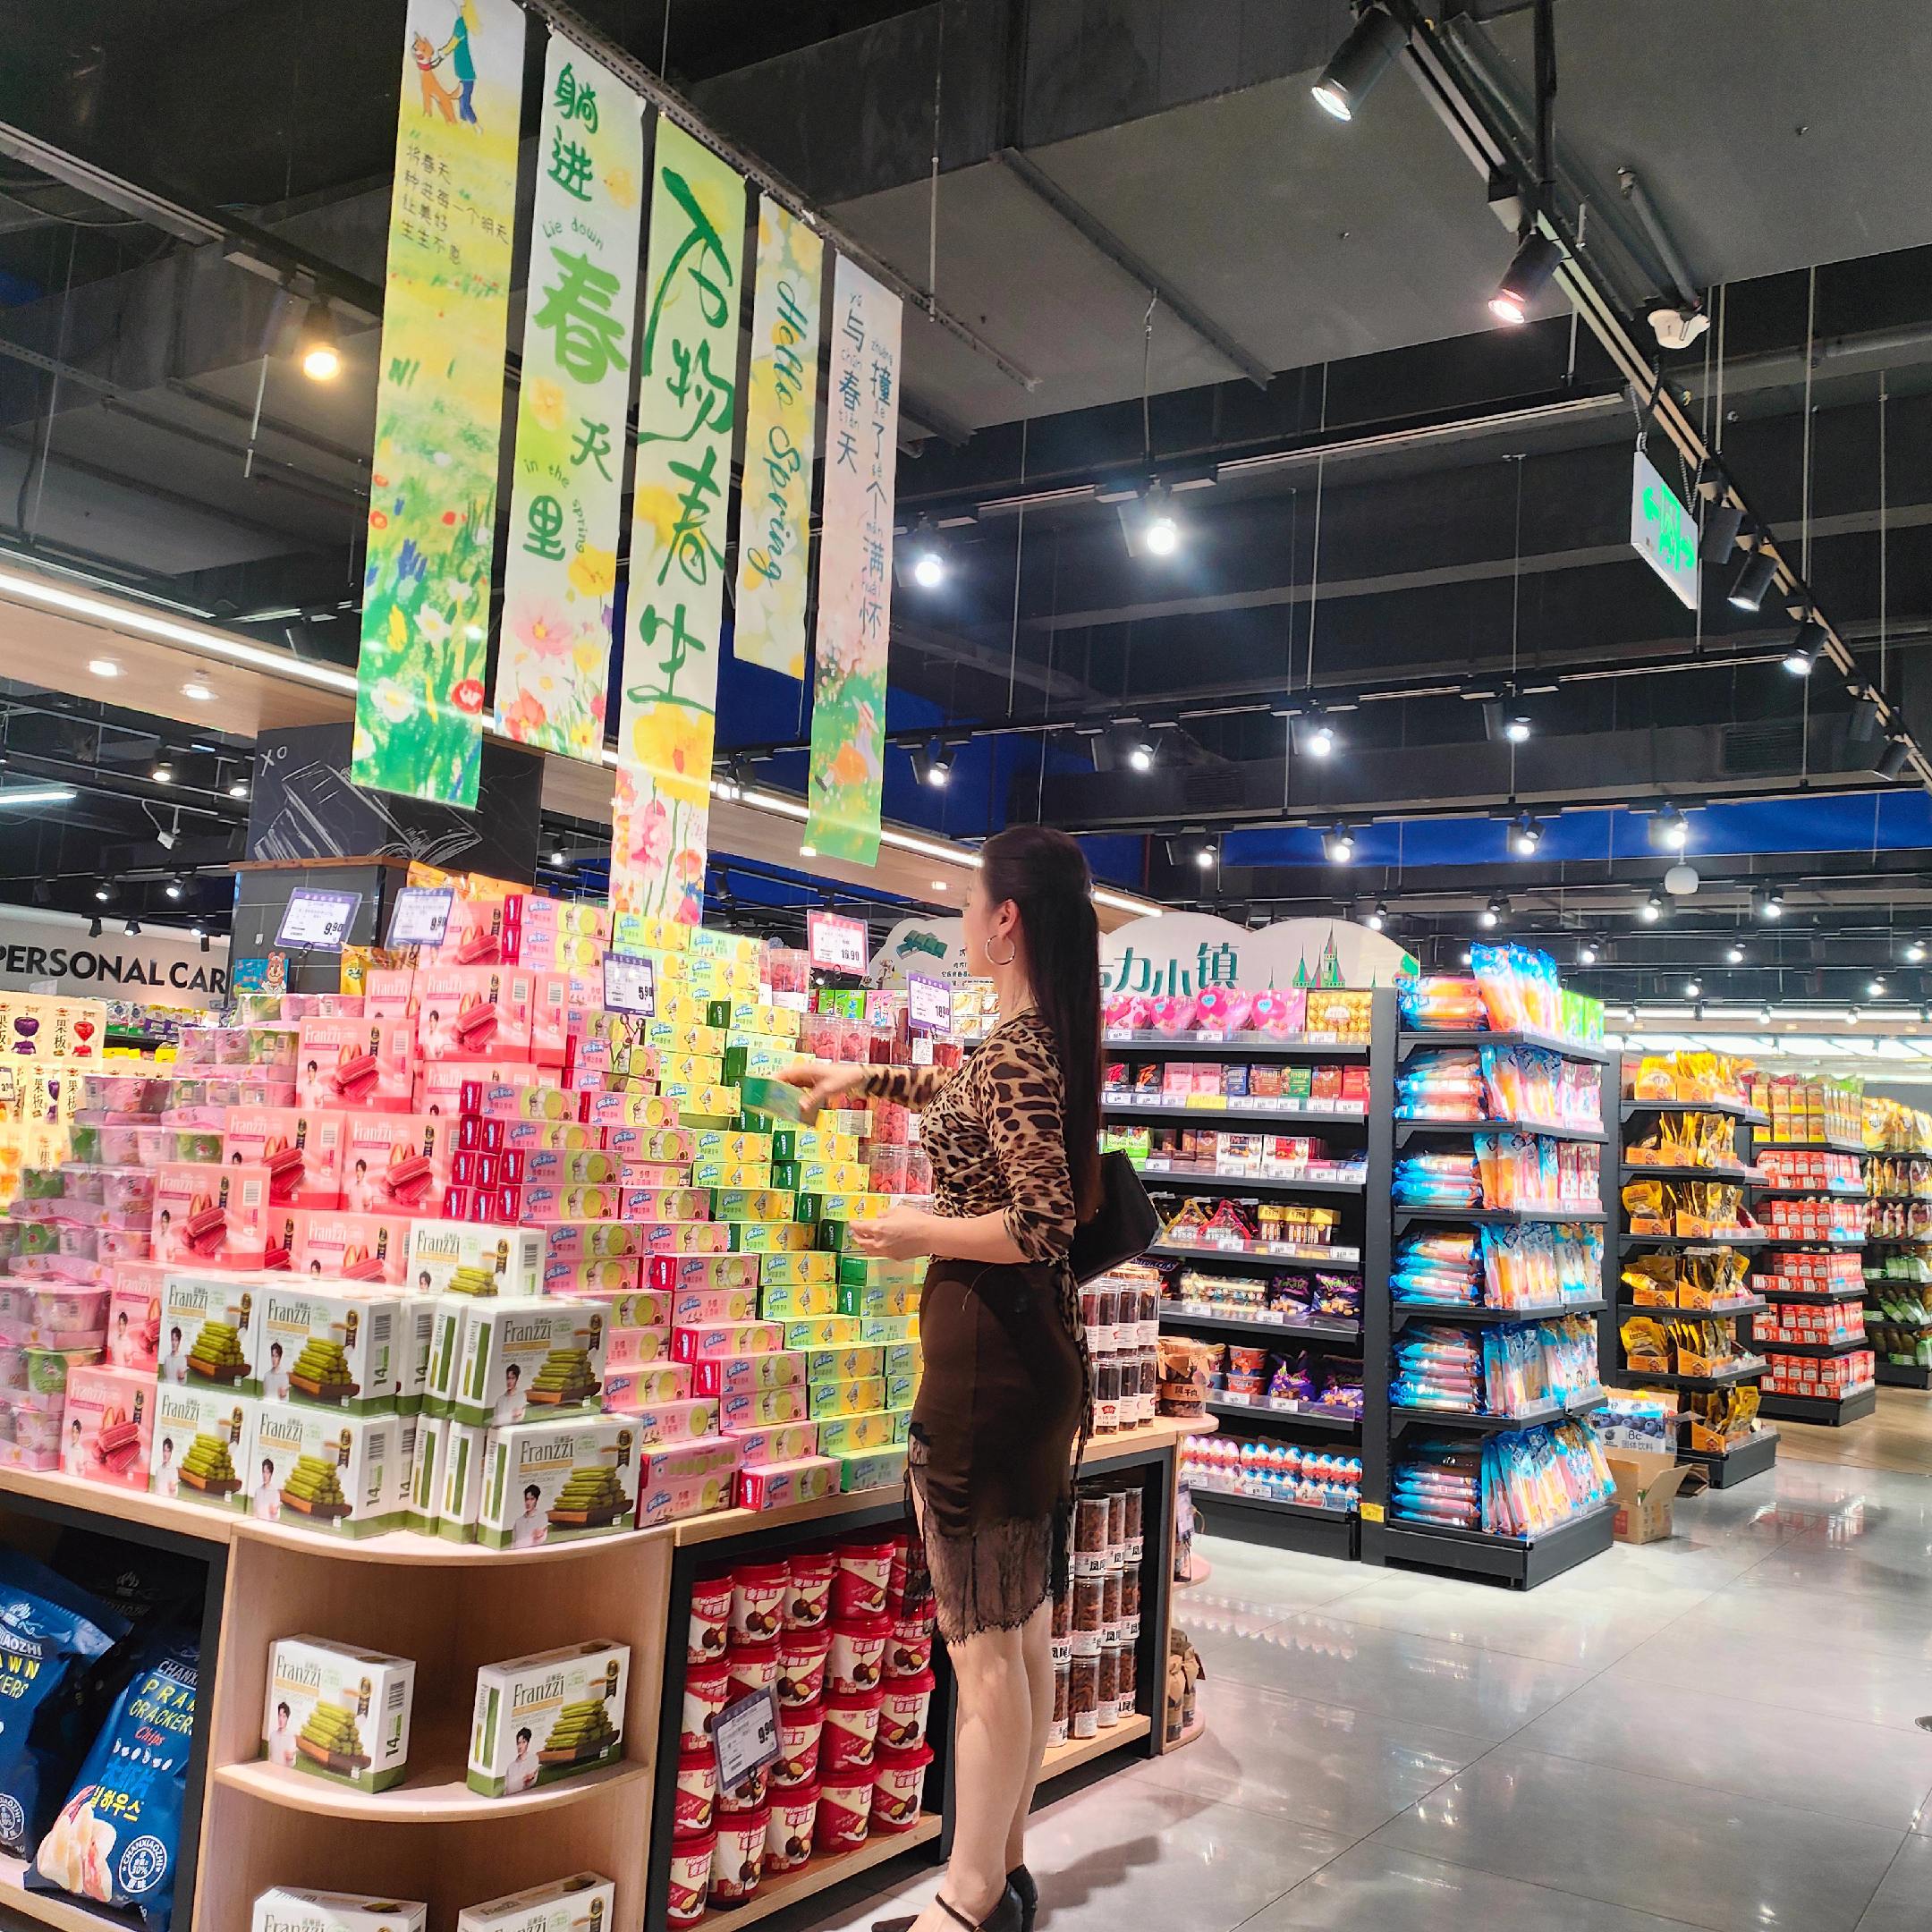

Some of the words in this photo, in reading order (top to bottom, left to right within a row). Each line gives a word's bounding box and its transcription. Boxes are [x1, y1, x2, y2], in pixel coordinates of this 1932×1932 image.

[547, 63, 598, 201] 躺进
[542, 222, 563, 239] Lie
[571, 217, 604, 250] down
[773, 281, 809, 411] Hello
[571, 417, 614, 482] 天
[524, 457, 538, 473] in
[548, 464, 570, 488] the
[747, 426, 801, 588] Spring
[572, 498, 588, 553] spring
[417, 1230, 461, 1254] Franzzi
[168, 1284, 208, 1309] Franzzi
[268, 1298, 310, 1326] Franzzi
[504, 1319, 552, 1343] Franzzi
[373, 1366, 387, 1386] 14
[161, 1394, 200, 1421] Franzzi
[259, 1413, 302, 1442] Franzzi
[520, 1437, 574, 1463] Franzzi
[366, 1487, 381, 1507] 14
[157, 1660, 198, 1685] CHANX
[275, 1655, 322, 1687] Franzzi
[513, 1675, 565, 1707] Franzzi
[135, 1726, 167, 1747] Chips
[385, 1728, 400, 1759] 14
[123, 1839, 163, 1867] CHANXIAOZHI
